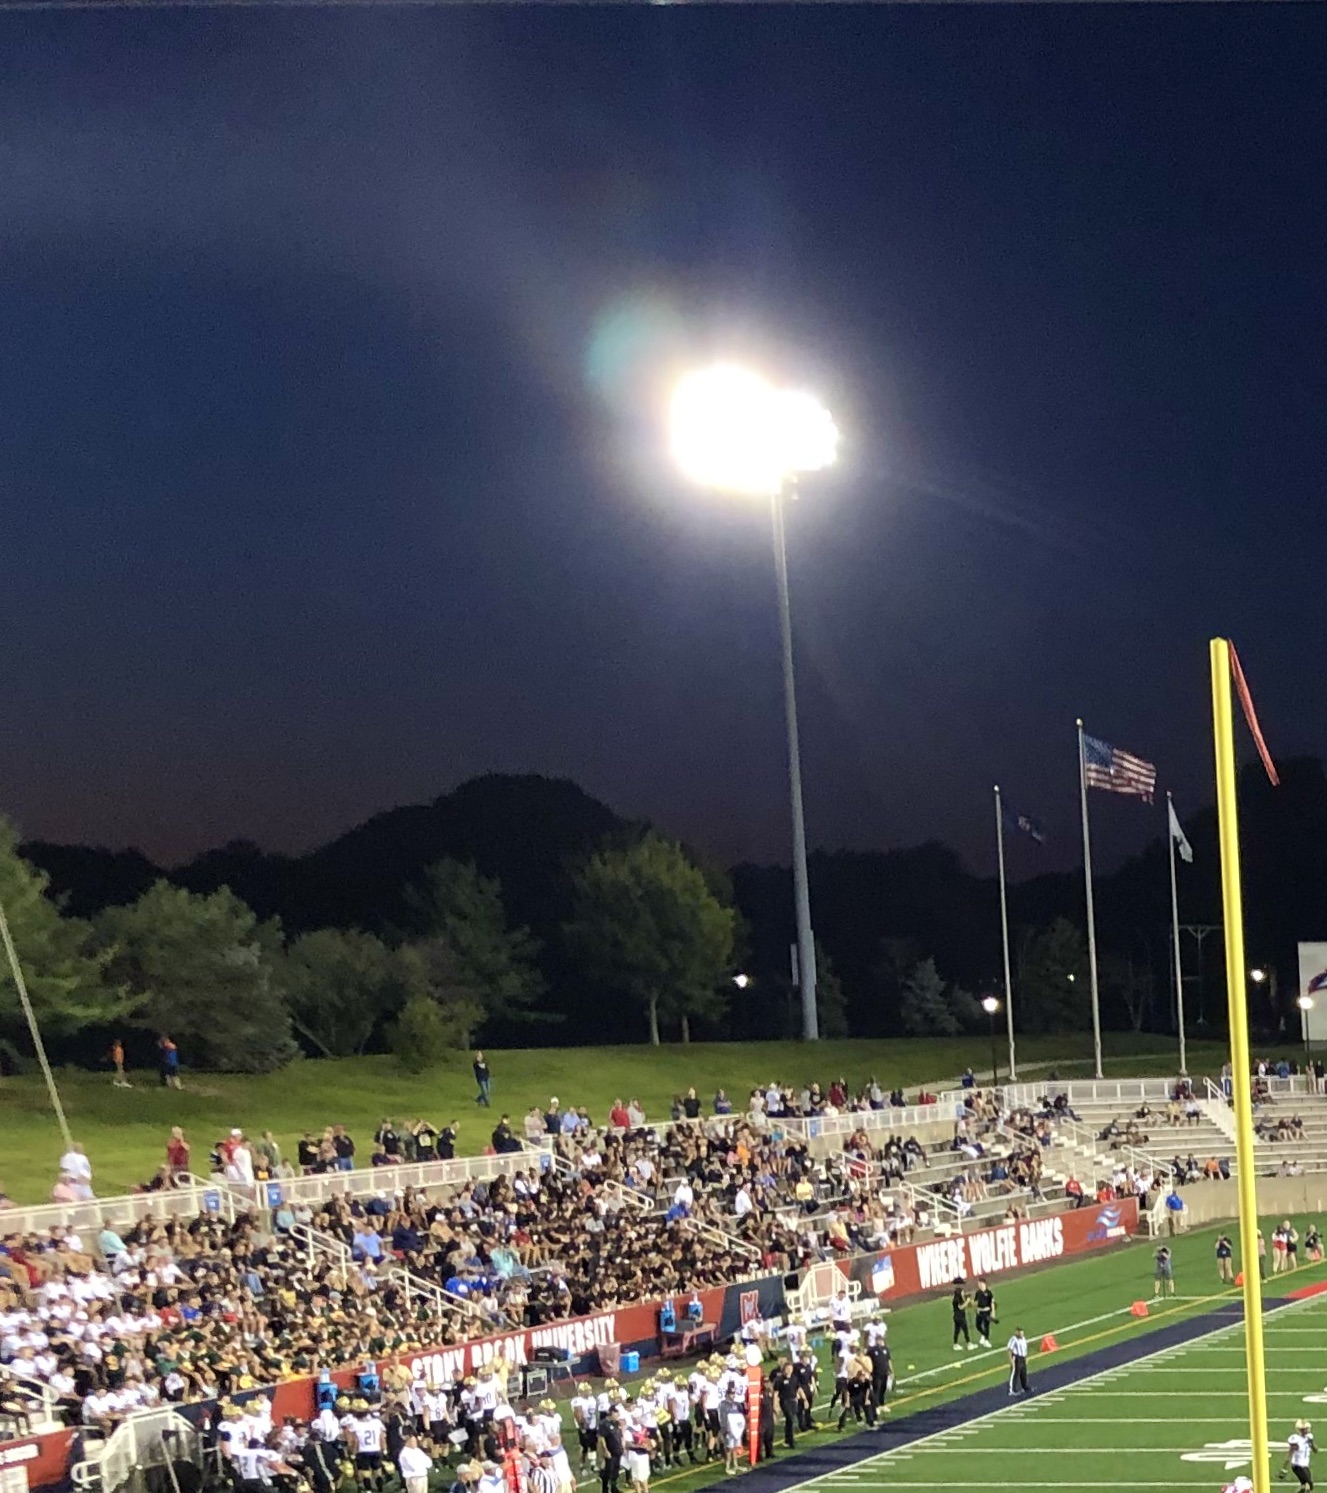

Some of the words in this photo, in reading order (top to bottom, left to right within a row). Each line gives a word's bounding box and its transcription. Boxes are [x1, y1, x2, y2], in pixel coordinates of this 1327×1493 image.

[916, 1238, 968, 1290] WHERE
[968, 1226, 1019, 1276] WOLFIE
[1019, 1217, 1064, 1264] BANKS
[410, 1347, 465, 1386] STONY
[471, 1334, 528, 1367] BROOK
[531, 1313, 617, 1354] UNIVERSITY
[363, 1430, 376, 1446] 21
